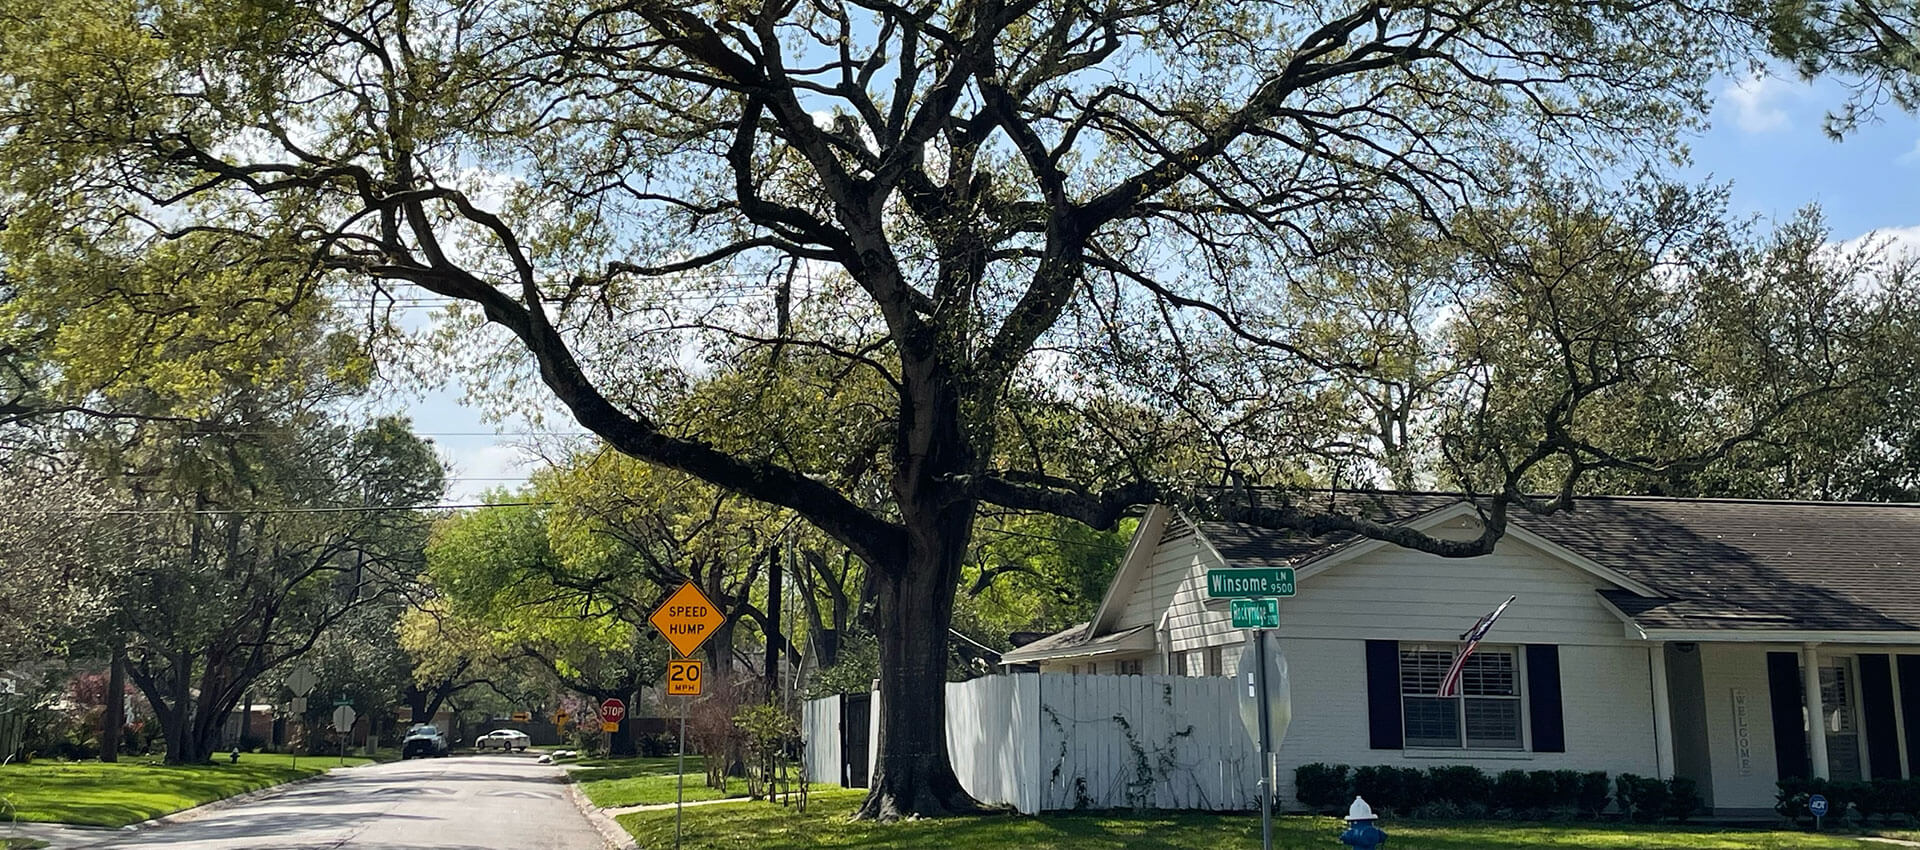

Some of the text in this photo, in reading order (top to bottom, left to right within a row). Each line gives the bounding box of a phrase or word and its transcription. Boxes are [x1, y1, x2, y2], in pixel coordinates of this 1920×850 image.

[1212, 571, 1287, 592] Winsome LN
[1271, 583, 1293, 593] 9500
[669, 606, 708, 617] SPEED
[669, 624, 705, 635] HUMP
[671, 665, 700, 682] 20
[602, 706, 624, 716] STOP
[1736, 695, 1751, 768] WELCOME
